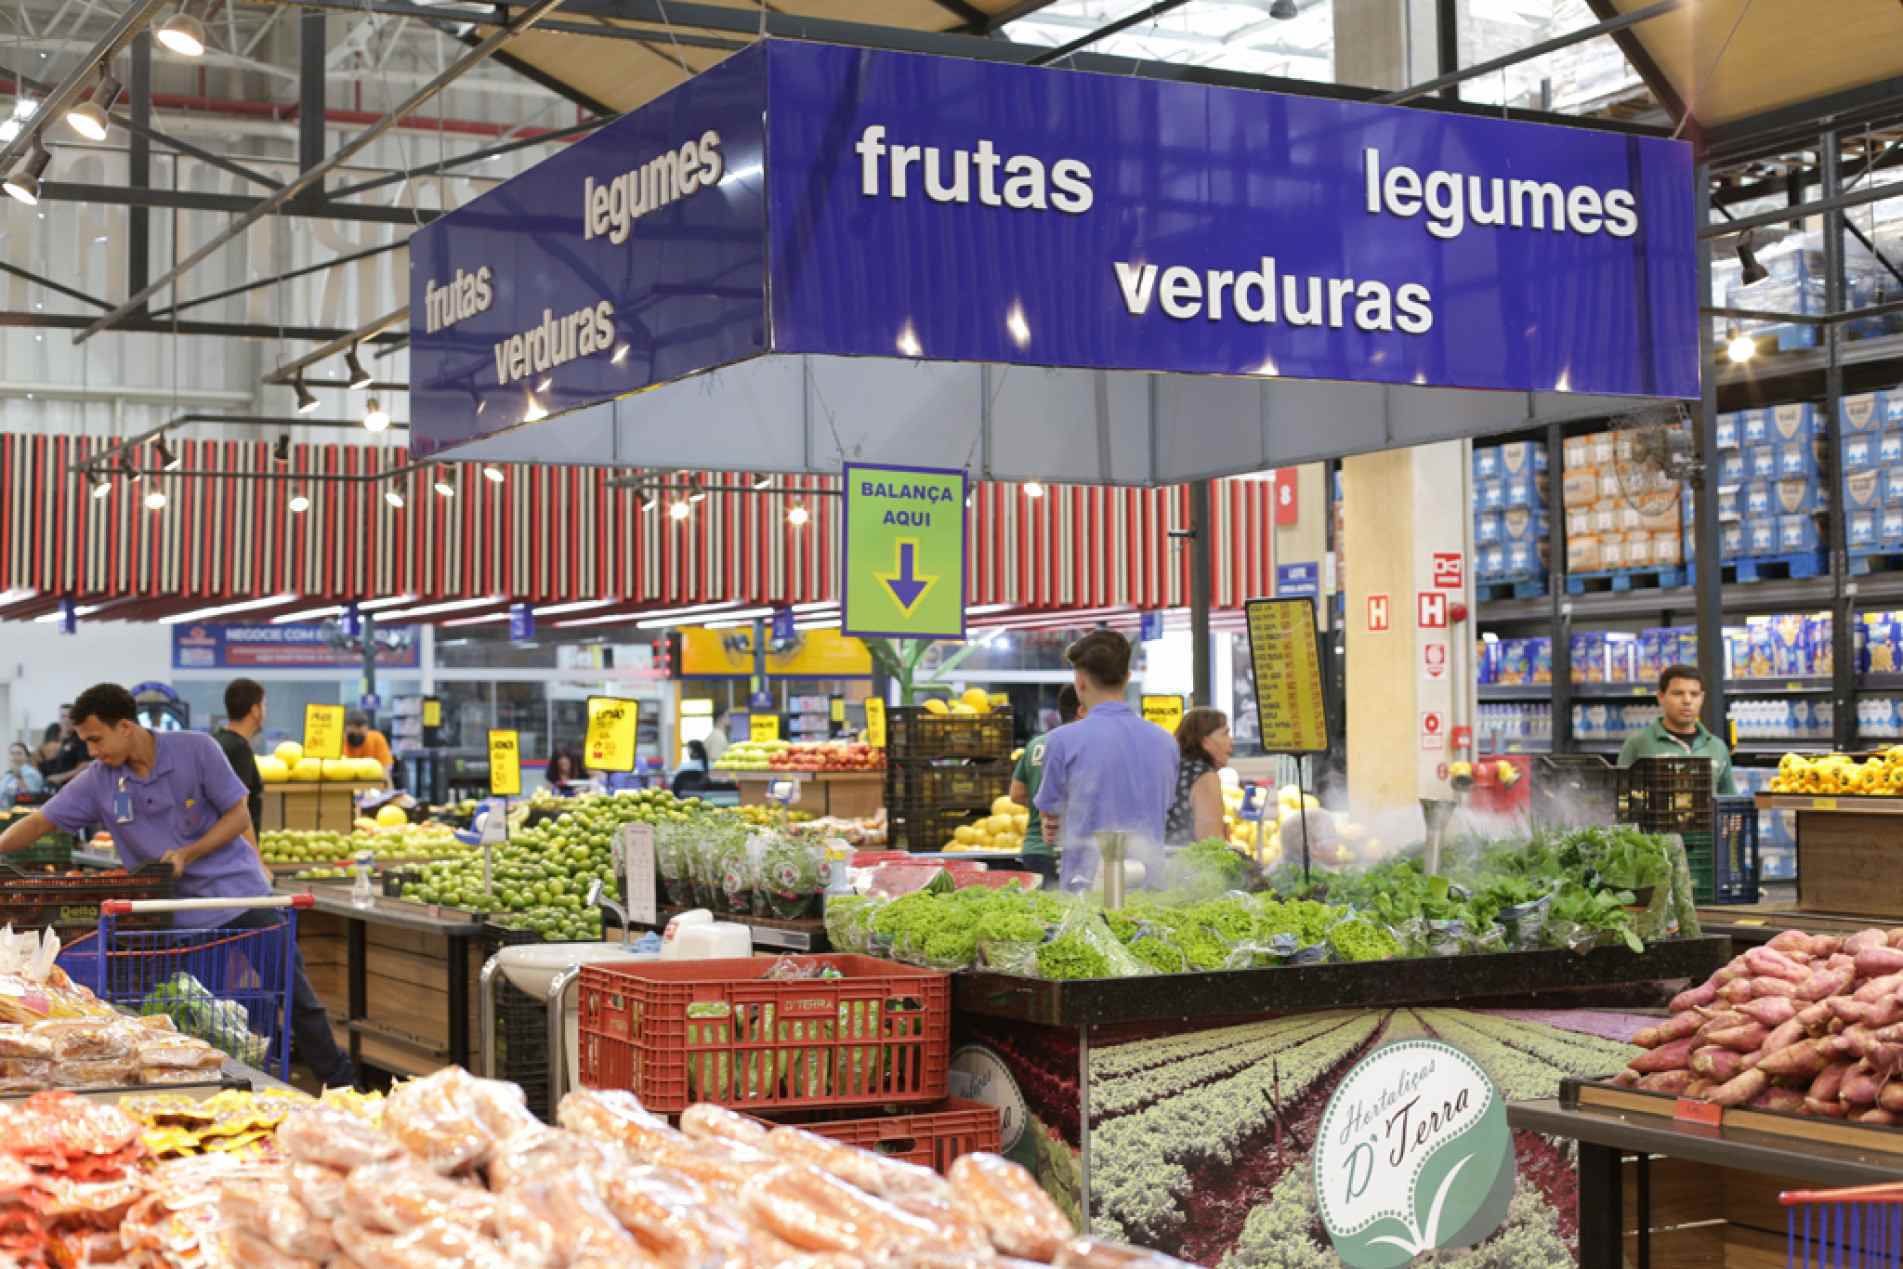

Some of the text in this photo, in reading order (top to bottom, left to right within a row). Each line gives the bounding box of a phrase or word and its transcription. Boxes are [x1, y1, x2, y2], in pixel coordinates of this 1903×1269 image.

[584, 130, 722, 245] legumes
[856, 125, 1094, 213] frutas
[1366, 147, 1638, 239] legumes
[425, 265, 493, 334] frutas
[1114, 256, 1434, 334] verduras
[494, 300, 616, 385] verduras
[861, 482, 954, 504] BALANÇA
[883, 510, 931, 527] AQUI
[1420, 596, 1444, 626] H
